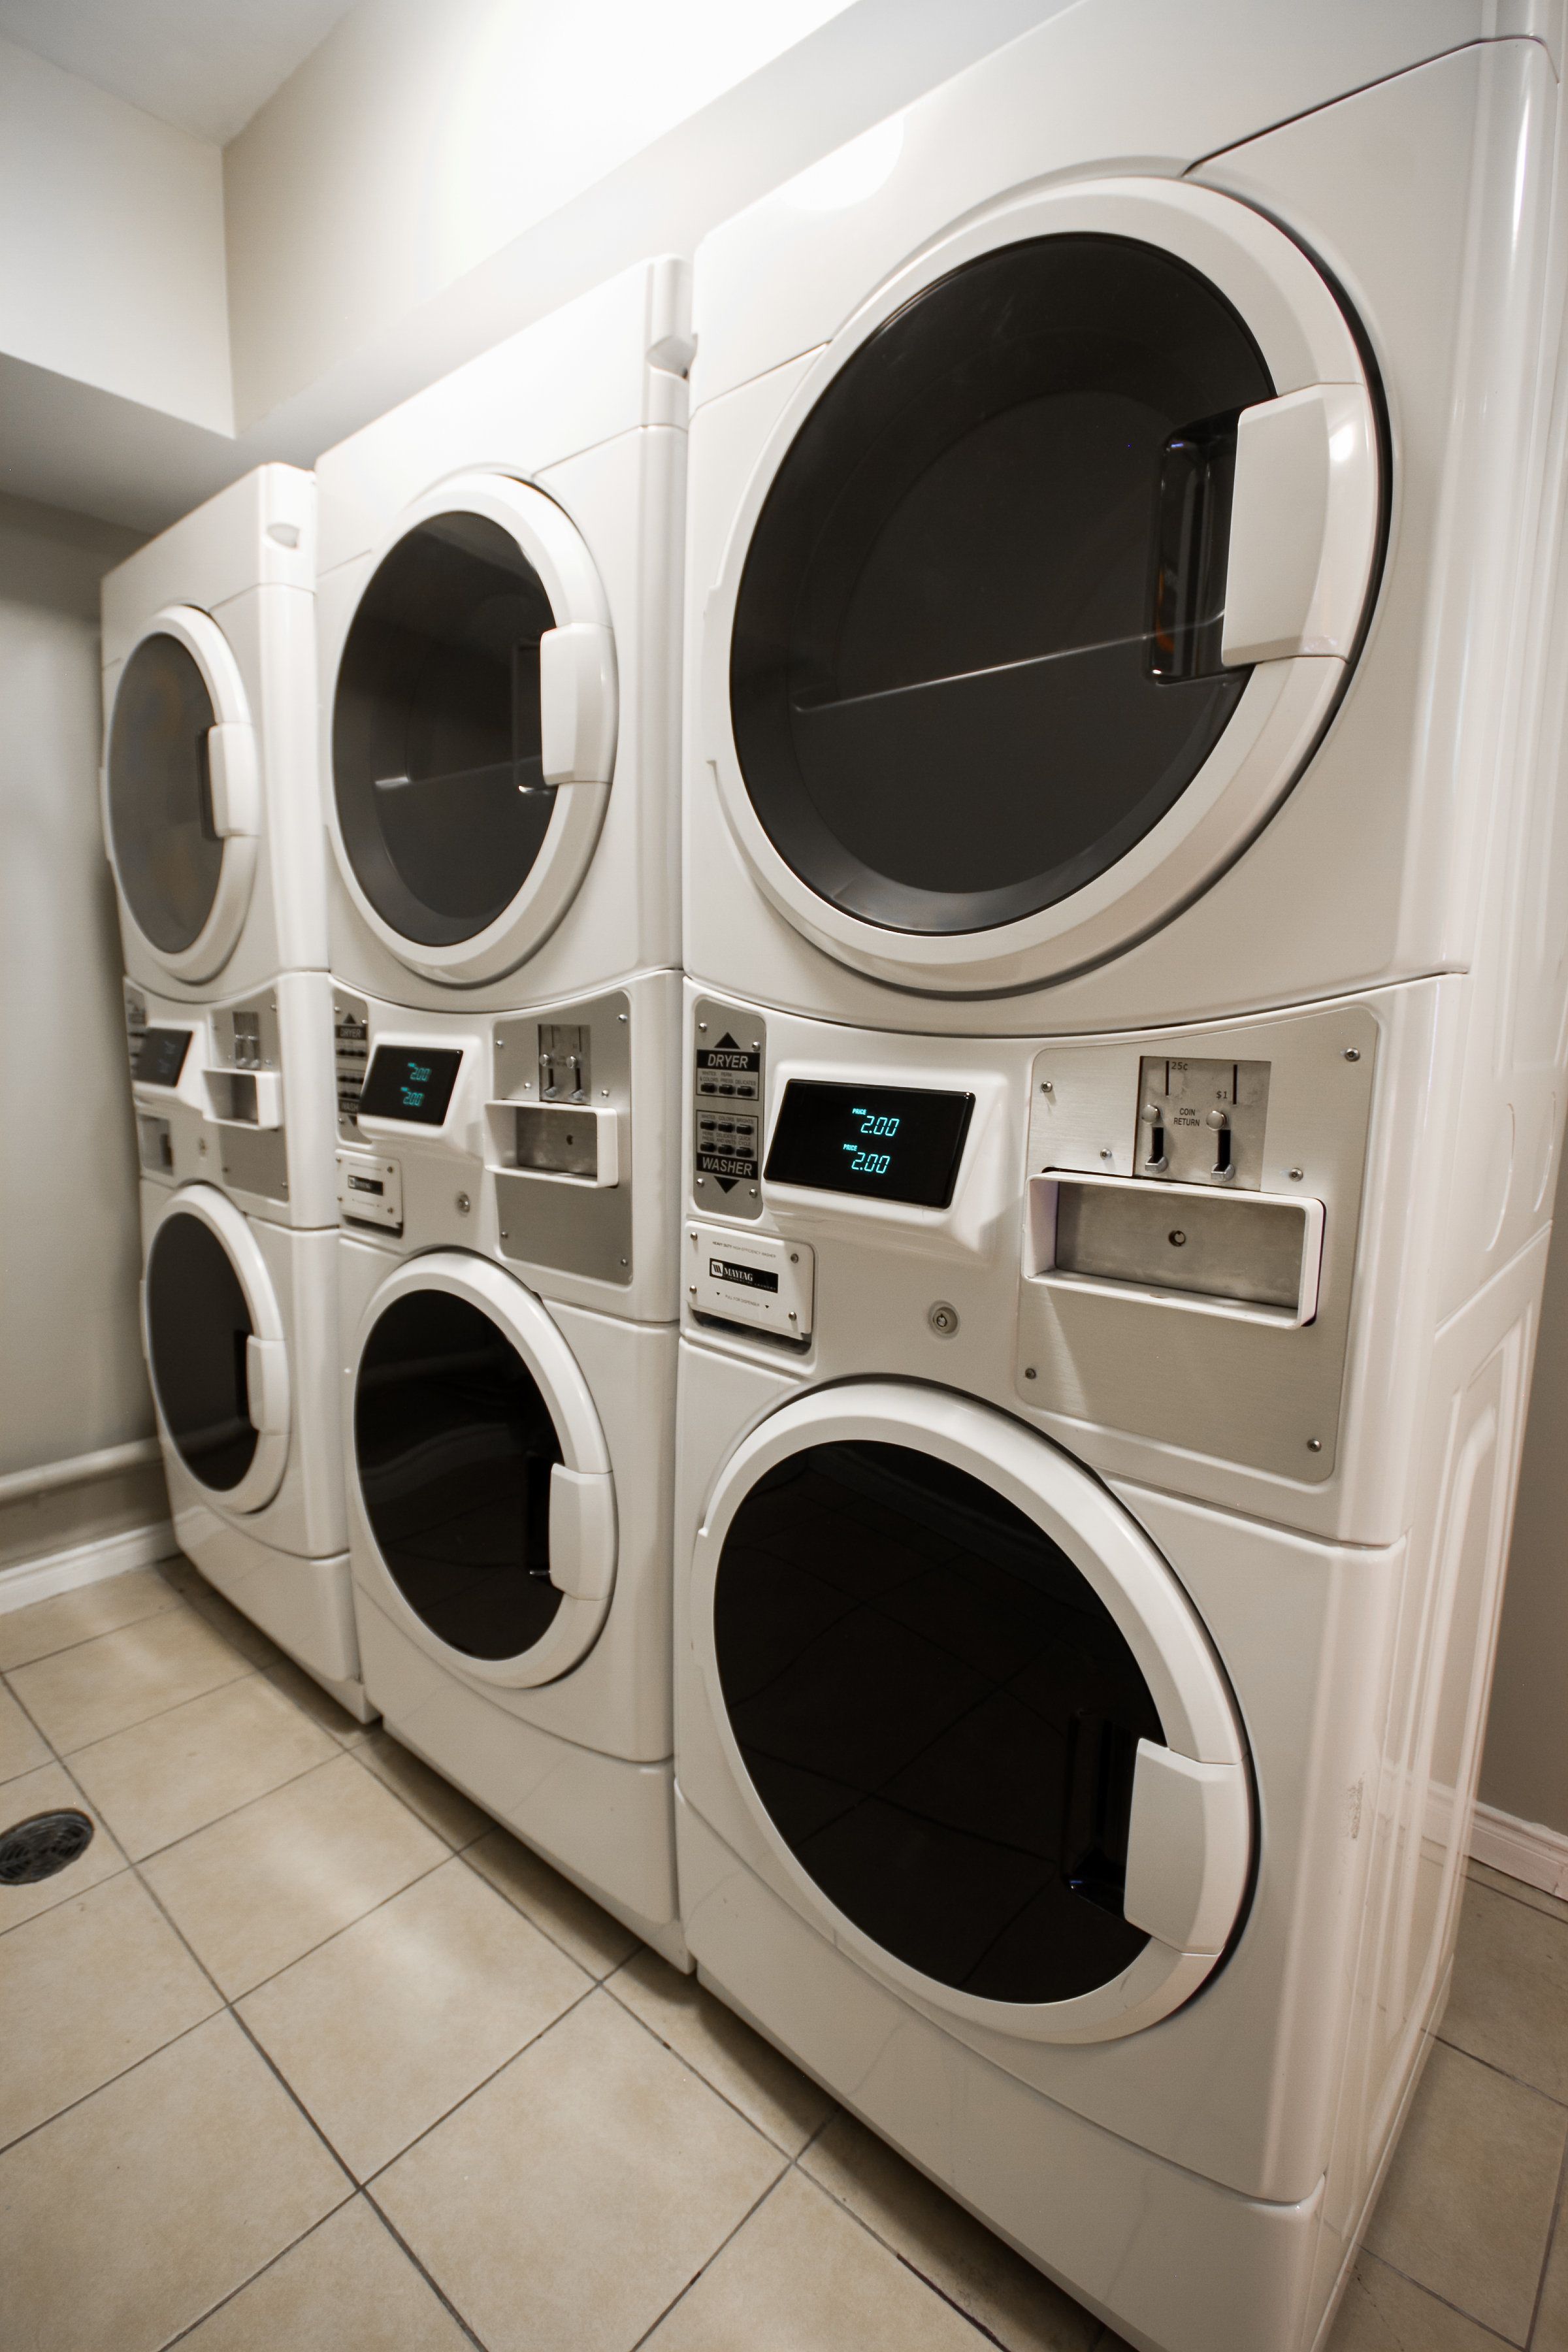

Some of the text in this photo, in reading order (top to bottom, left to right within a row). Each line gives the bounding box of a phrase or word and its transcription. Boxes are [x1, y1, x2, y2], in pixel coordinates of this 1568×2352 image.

[708, 1054, 748, 1068] DRYER
[1217, 1090, 1228, 1099] $1
[860, 1115, 900, 1136] 2.00
[1173, 1117, 1200, 1126] RETURN
[702, 1157, 752, 1176] WASHER
[851, 1152, 890, 1173] 2.00
[724, 1267, 753, 1282] MAYTAG
